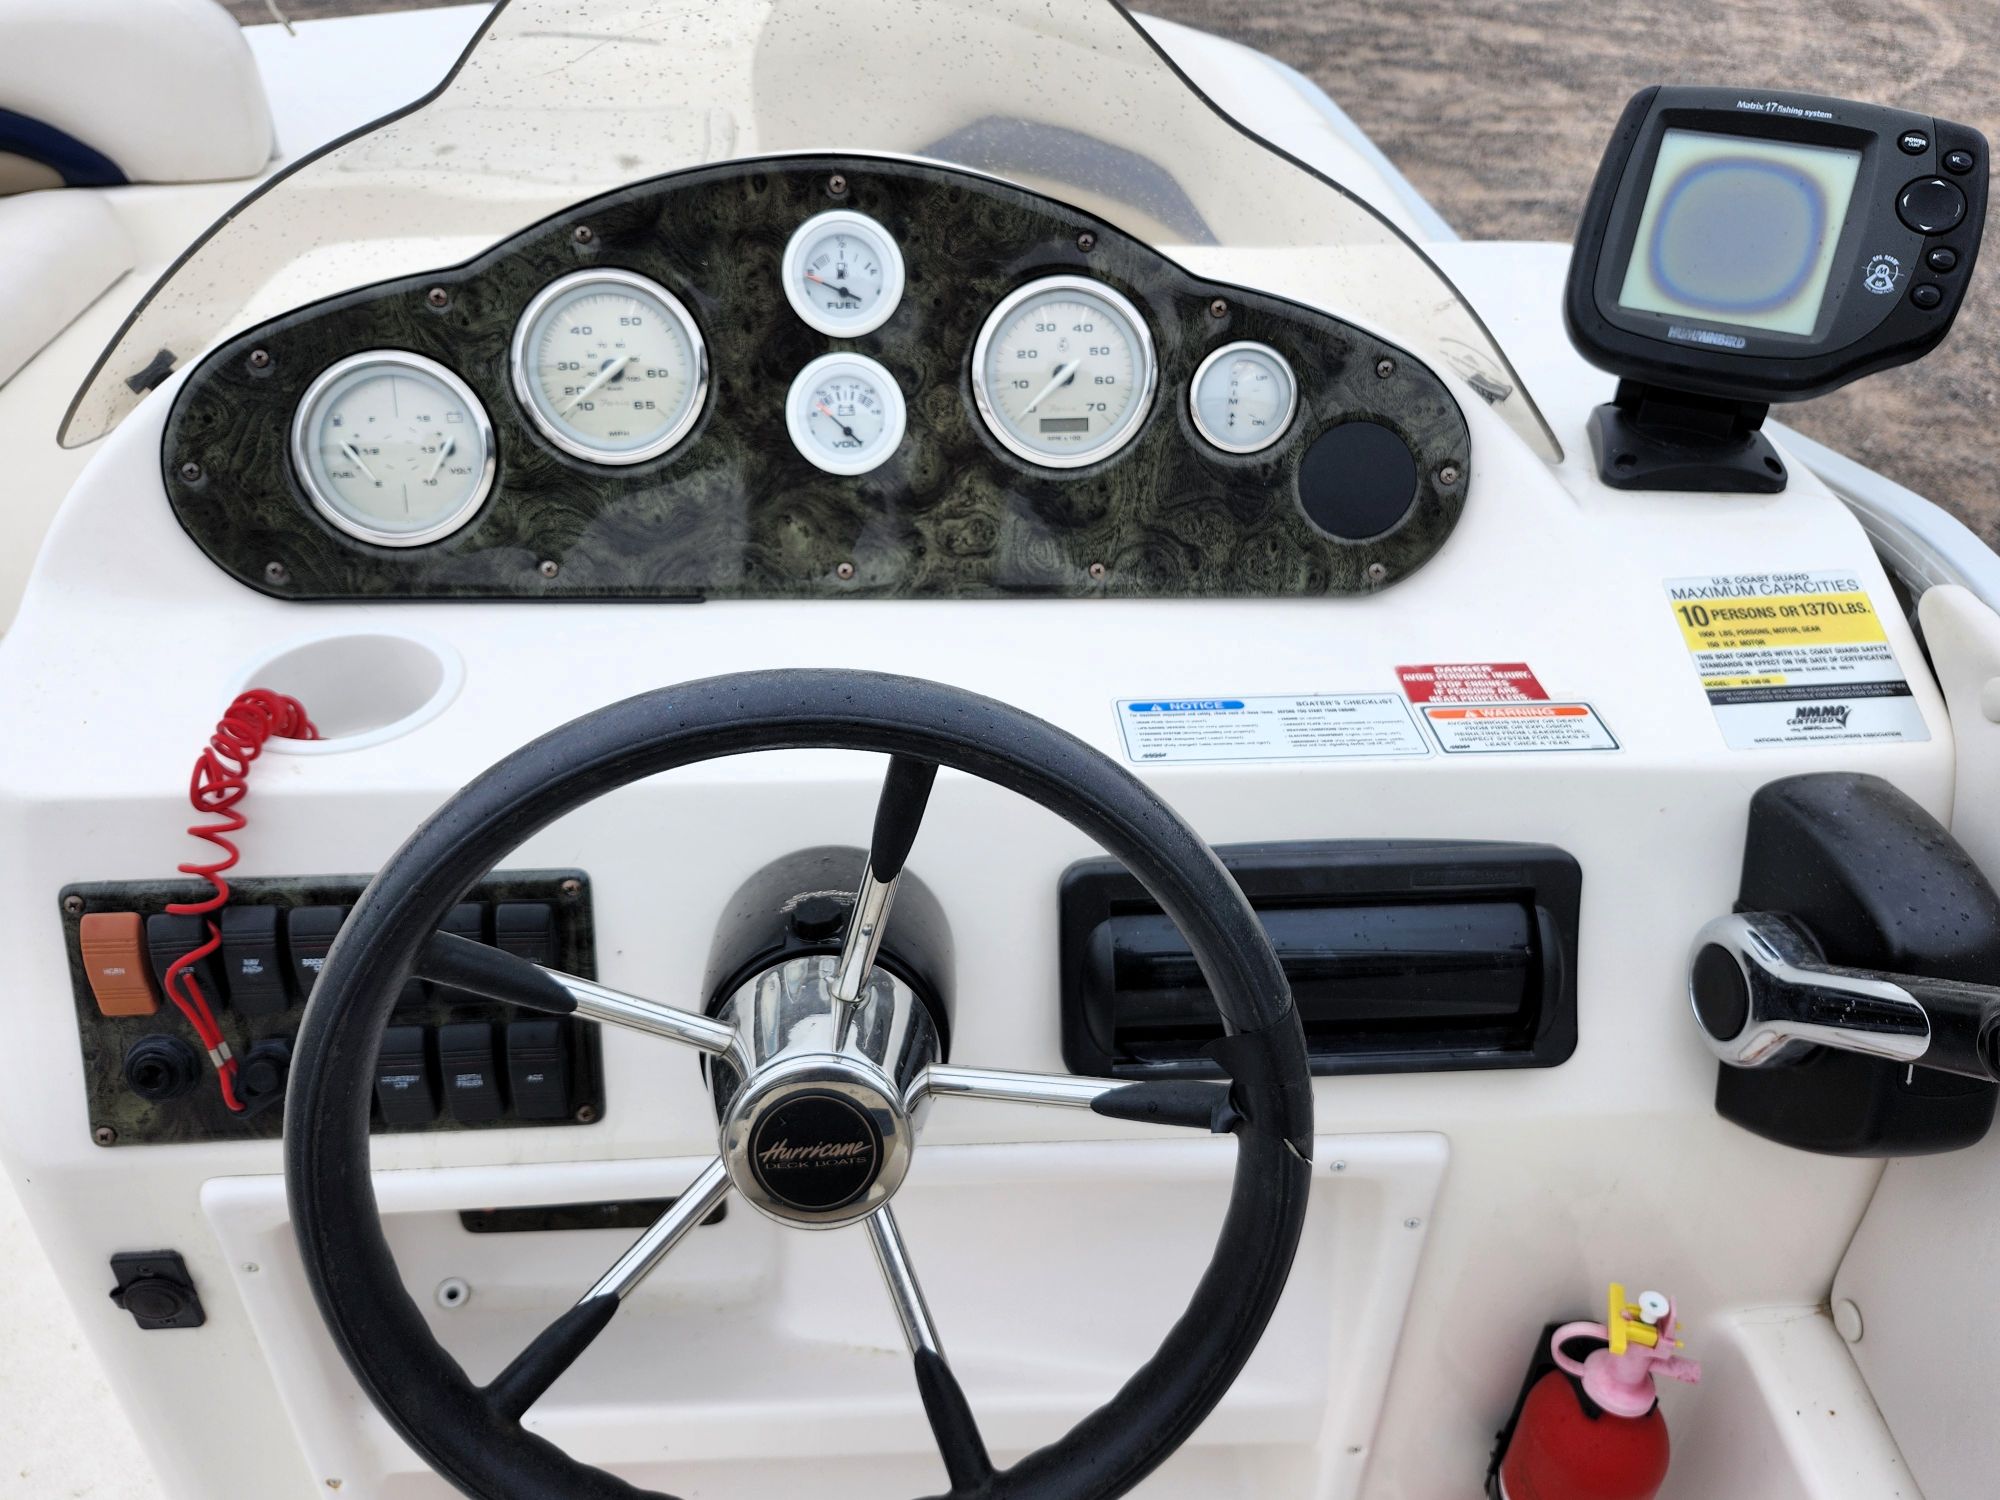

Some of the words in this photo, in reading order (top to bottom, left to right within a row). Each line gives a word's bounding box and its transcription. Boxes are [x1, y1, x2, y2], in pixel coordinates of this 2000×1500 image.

[1736, 100, 1764, 111] Matrix
[1765, 101, 1779, 112] 17
[1777, 105, 1804, 116] fishing
[1804, 109, 1832, 119] system
[1904, 136, 1927, 147] POWER
[827, 302, 860, 310] FUEL
[620, 317, 642, 326] 50
[570, 326, 592, 335] 40
[1035, 323, 1056, 332] 30
[1072, 324, 1093, 333] 40
[1017, 350, 1038, 359] 20
[1089, 347, 1110, 356] 50
[557, 362, 580, 371] 30
[647, 369, 668, 378] 60
[1011, 380, 1029, 389] 10
[1094, 376, 1115, 385] 60
[576, 402, 595, 412] 10
[633, 401, 656, 410] 65
[1087, 403, 1106, 412] 70
[832, 441, 863, 449] VOLT
[332, 471, 355, 479] FUEL
[450, 467, 472, 475] VOLT
[1711, 576, 1732, 585] U.S.
[1734, 575, 1769, 584] COAST
[1772, 573, 1809, 582] GUARD
[1670, 585, 1756, 599] MAXIMUM
[1759, 579, 1859, 596] CAPACITIES
[1678, 605, 1710, 627] 10
[1710, 606, 1777, 620] PERSONS
[1779, 605, 1800, 617] OR
[1799, 601, 1838, 616] 1370
[1838, 602, 1871, 615] LBS.
[1697, 653, 1714, 661] THIS
[1715, 652, 1734, 660] BOAT
[1735, 651, 1773, 659] COMPLIES
[1809, 647, 1833, 655] COAST
[1834, 646, 1859, 654] GUARD
[1860, 645, 1888, 653] SAFETY
[1700, 661, 1743, 669] STANDARDS
[1809, 656, 1827, 664] DATE
[1840, 654, 1892, 662] CERTIFICATION
[1433, 665, 1494, 673] DANGER
[1403, 673, 1434, 681] AVOID
[1435, 672, 1490, 680] PERSONAL
[1433, 680, 1463, 688] STOP
[1464, 679, 1511, 687] ENGINES
[1446, 687, 1496, 695] PERSONS
[1498, 686, 1520, 694] ARE
[1343, 698, 1393, 706] CHECKLIST
[1429, 695, 1459, 703] NEAR
[1169, 701, 1225, 710] NOTICE
[1483, 707, 1555, 717] WARNING
[1795, 705, 1846, 718] NMMA
[1786, 716, 1834, 726] CERTIFIED
[758, 1138, 872, 1163] Hurricane
[765, 1161, 810, 1170] DECK
[815, 1156, 867, 1168] BOATS
